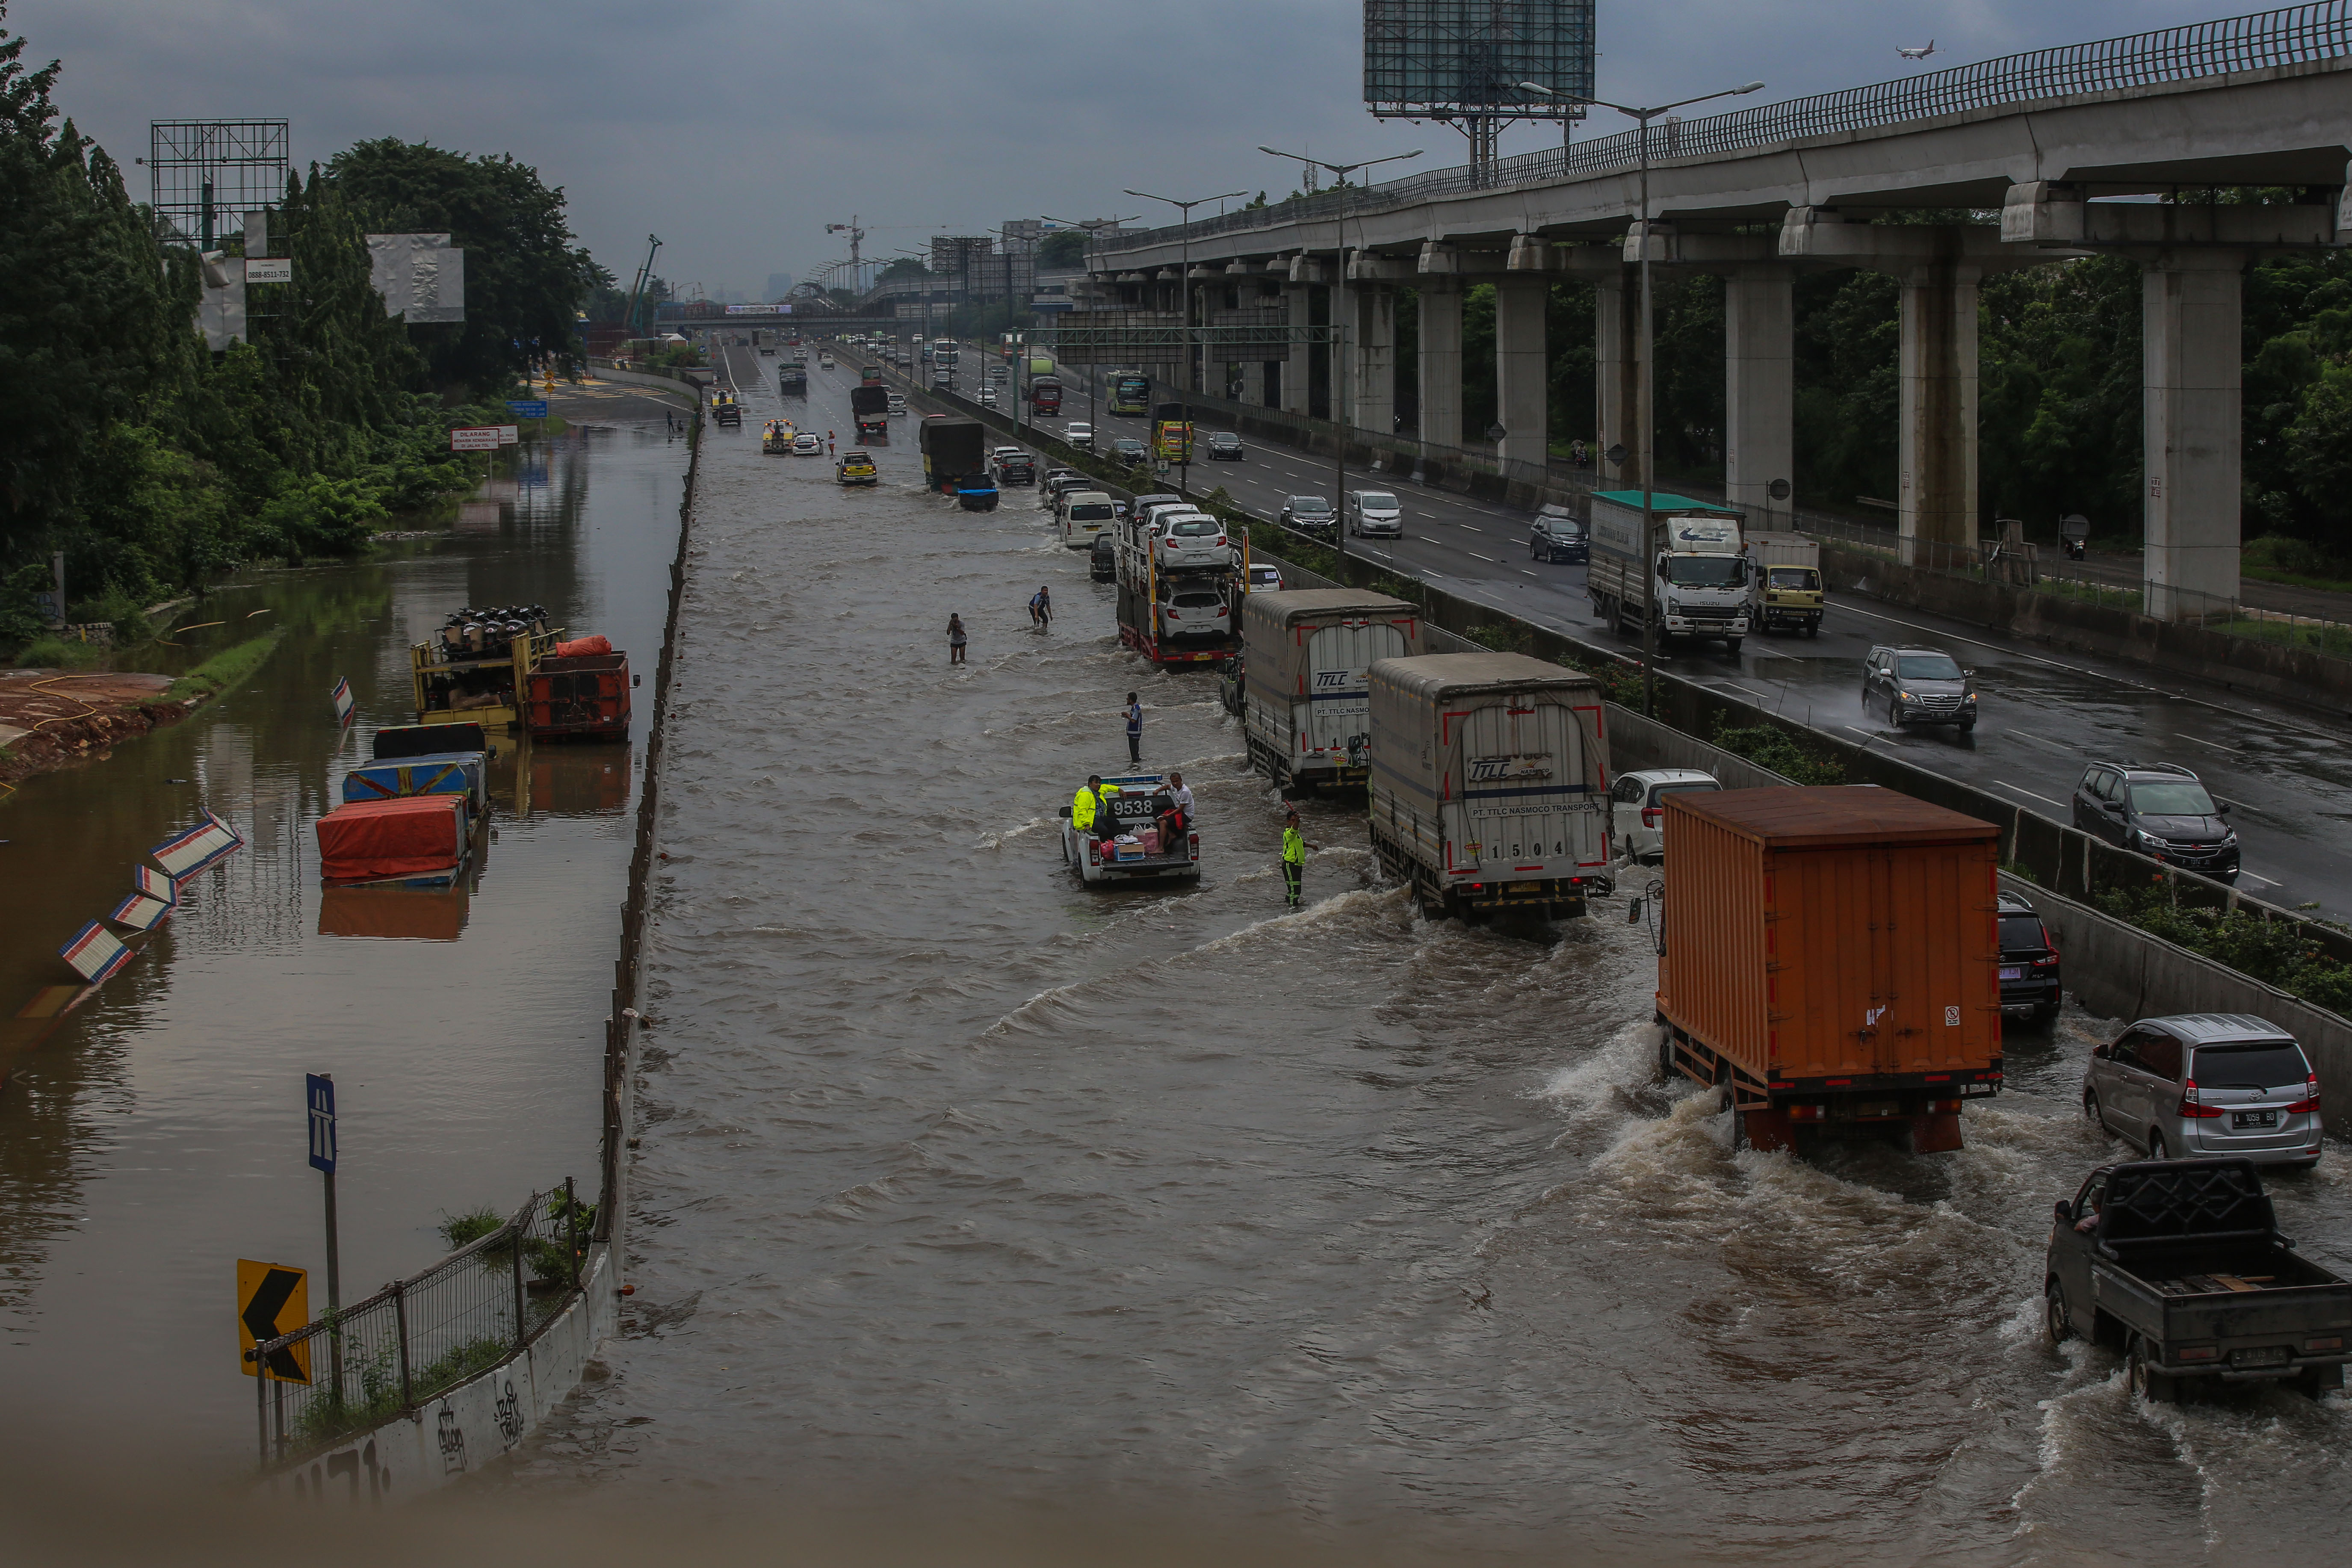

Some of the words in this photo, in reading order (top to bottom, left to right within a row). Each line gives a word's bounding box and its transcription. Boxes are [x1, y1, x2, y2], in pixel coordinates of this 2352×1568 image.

[248, 271, 290, 279] 0888-8511-732
[1317, 670, 1349, 687] TTLC
[1471, 759, 1511, 779] TTLC
[1114, 800, 1153, 815] 9538
[1509, 806, 1550, 815] NASMOCO
[1551, 803, 1600, 812] TRANSPORT
[2235, 1114, 2240, 1122] A
[2246, 1113, 2260, 1122] 1059
